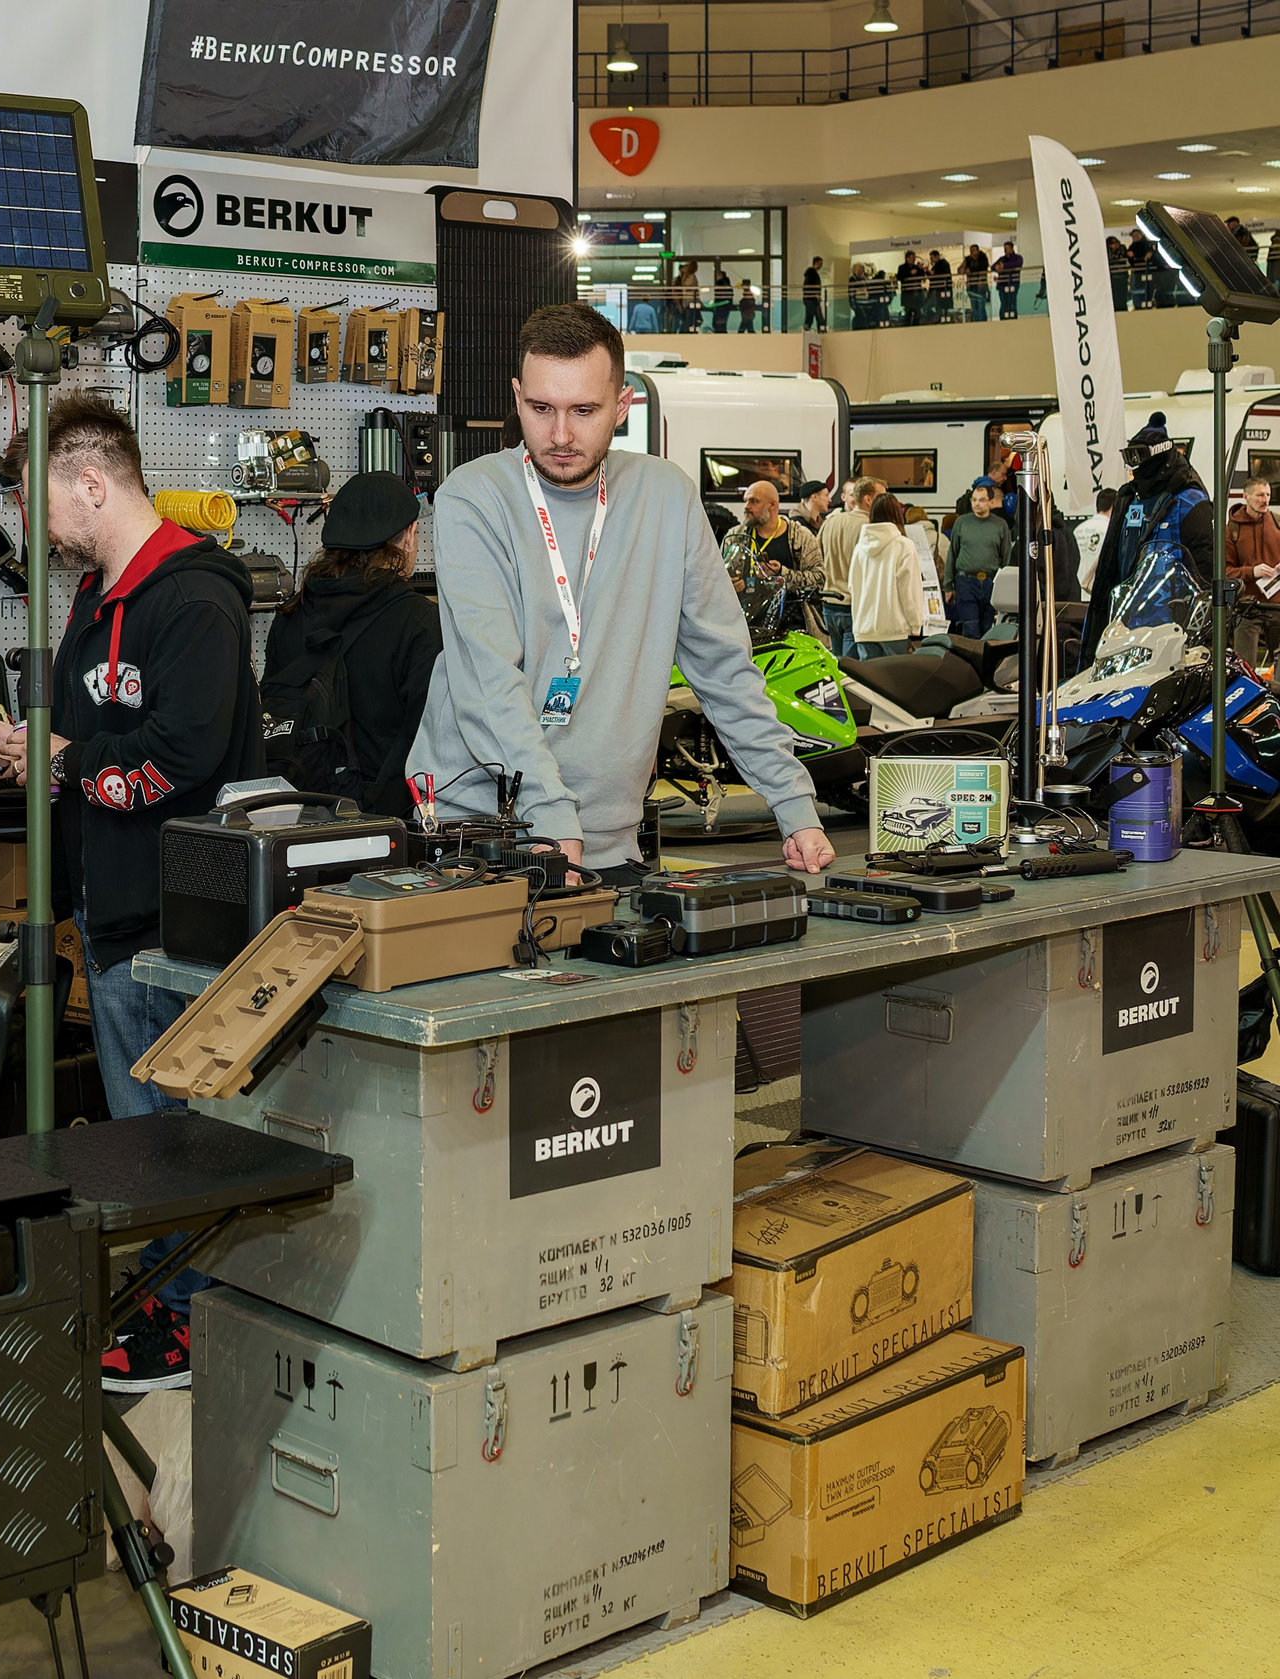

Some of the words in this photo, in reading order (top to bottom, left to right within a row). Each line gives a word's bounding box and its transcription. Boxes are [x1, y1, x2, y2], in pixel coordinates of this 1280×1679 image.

[620, 128, 639, 159] D
[216, 193, 373, 238] BERKUT
[637, 226, 646, 240] 1
[236, 253, 396, 277] BERKUT-COMPRESSOR.COM
[1245, 430, 1268, 440] KARSO
[950, 793, 975, 803] SPEC
[978, 793, 993, 802] 2M
[1117, 996, 1180, 1028] BERKUT
[534, 1119, 634, 1162] BERKUT
[538, 1235, 605, 1265] КОМПЛЕКТ
[622, 1212, 693, 1244] 5320361905
[539, 1266, 574, 1287] ЯЩИК
[599, 1275, 615, 1293] 32
[622, 1271, 637, 1287] КГ
[798, 1352, 860, 1404] BERKUT
[872, 1299, 963, 1366] SPECIALIST
[797, 1396, 879, 1433] BERKUT
[883, 1345, 1004, 1398] SPECIALIST
[1145, 1389, 1156, 1403] 32
[825, 1472, 855, 1494] MAXIMUM
[856, 1460, 881, 1481] OUTPUT
[826, 1487, 843, 1505] TWIN
[843, 1484, 855, 1498] AIR
[856, 1465, 896, 1493] COMPRESSOR
[816, 1544, 888, 1600] BERKUT
[902, 1485, 1014, 1558] SPECIALIST
[543, 1563, 608, 1601] КОМПЛЕКТ
[737, 1567, 766, 1583] BERKUT
[544, 1597, 577, 1622] ЯЩИК
[600, 1601, 614, 1618] 32
[623, 1594, 638, 1612] КГ
